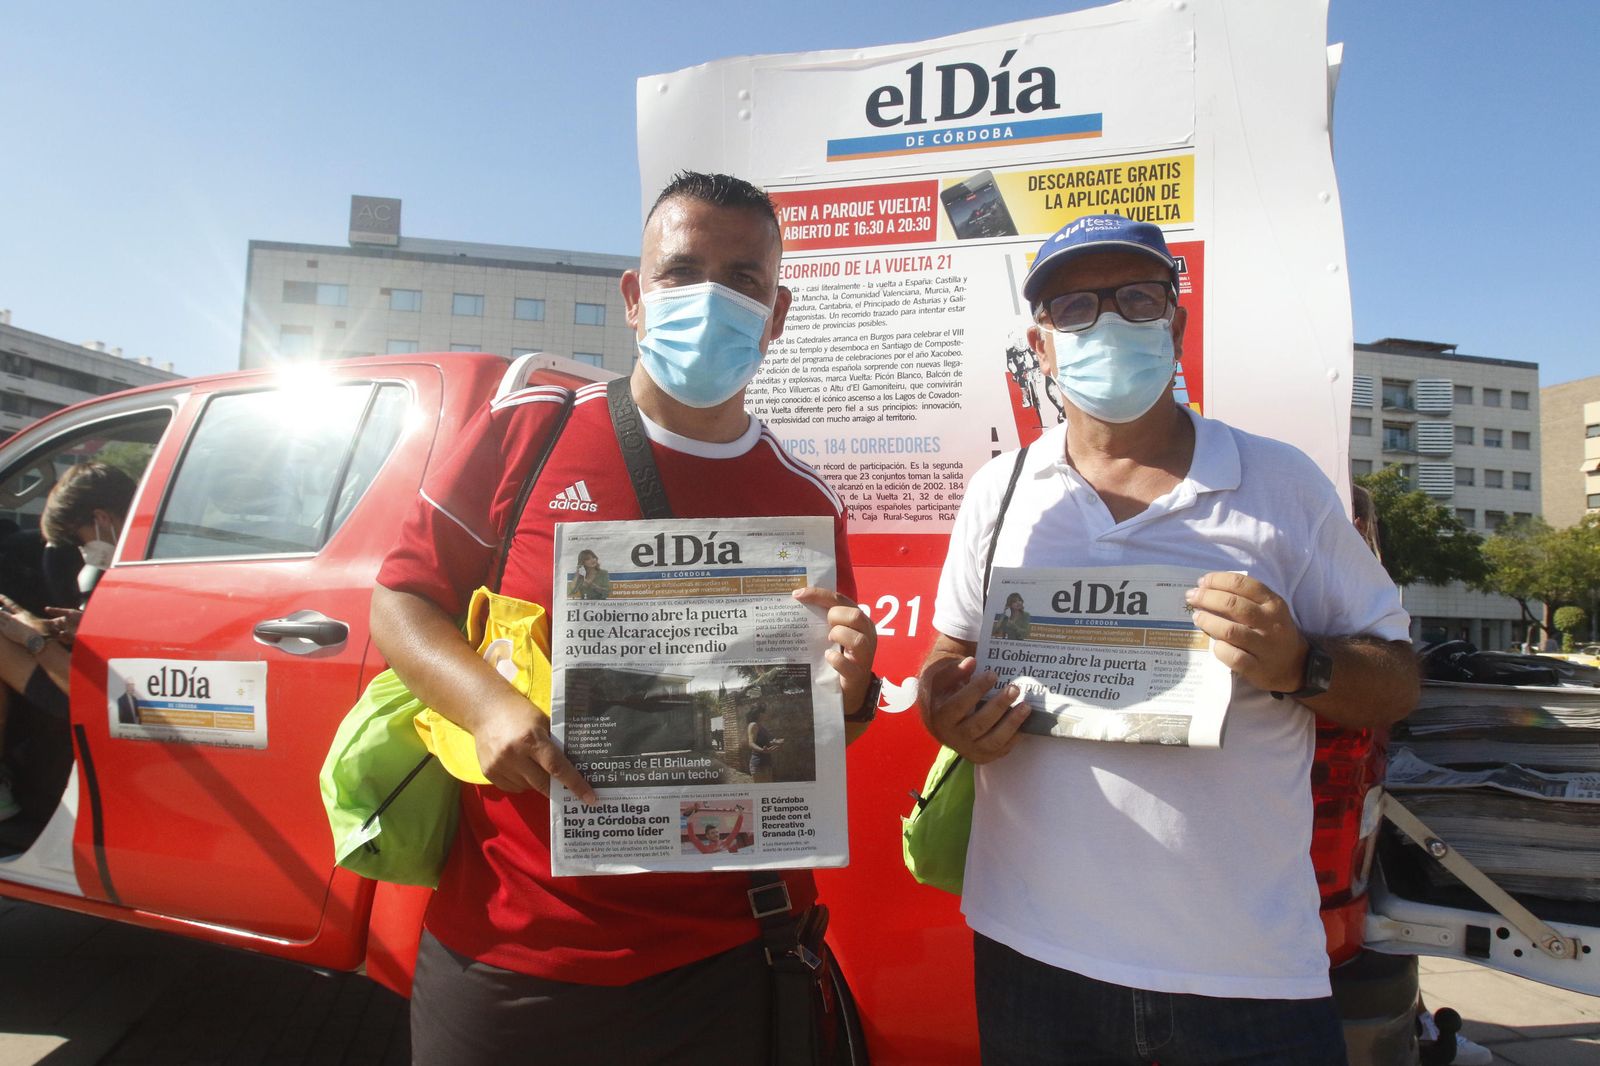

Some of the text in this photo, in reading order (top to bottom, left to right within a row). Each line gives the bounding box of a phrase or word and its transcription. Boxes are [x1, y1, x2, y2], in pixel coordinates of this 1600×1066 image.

[934, 49, 1060, 122] Día
[906, 126, 1013, 147] DE CÓRDOBA
[1028, 162, 1180, 192] DESCARGATE GRATIS
[1046, 182, 1180, 210] LA APLICACIÓN DE
[358, 204, 391, 220] AC
[778, 196, 931, 226] ¡VEN A PARQUE VUELTA!
[1126, 204, 1180, 222] VUELTA
[784, 216, 930, 240] ABIERTO DE 16:30 A 20:30
[780, 254, 952, 280] ECORRIDO DE LA VUELTA 21
[754, 404, 768, 414] Una
[771, 404, 792, 414] Vuelta
[794, 403, 824, 413] diferente
[827, 404, 842, 414] pero
[845, 402, 856, 412] fiel
[882, 400, 918, 412] principios:
[922, 399, 962, 410] innovación,
[782, 436, 940, 456] IPOS, 184 CORREDORES
[824, 460, 845, 470] récord
[848, 460, 857, 470] de
[860, 460, 906, 472] participación.
[910, 460, 920, 469] Es
[922, 460, 930, 469] la
[932, 460, 964, 470] segunda
[844, 472, 858, 482] que
[860, 470, 870, 480] 23
[872, 470, 906, 482] conjuntos
[908, 470, 931, 480] toman
[934, 470, 940, 480] la
[941, 470, 964, 479] salida
[838, 480, 864, 490] alcanzó
[876, 481, 882, 490] la
[884, 480, 910, 490] edición
[912, 481, 922, 490] de
[924, 481, 946, 490] 2002.
[949, 480, 964, 490] 184
[850, 490, 964, 501] de La Vuelta 21, 32 de ellos
[549, 498, 598, 512] adidas
[876, 502, 912, 512] españoles
[860, 511, 956, 522] Caja Rural-Seguros RGA
[672, 531, 743, 566] Día
[1086, 580, 1149, 616] Día
[568, 608, 747, 622] El Gobierno abre la puerta
[566, 622, 738, 641] a que Alcaracejos reciba
[566, 640, 726, 658] ayudas por el incendio
[988, 648, 1000, 660] El
[1002, 650, 1058, 664] Gobierno
[1058, 653, 1088, 666] abre
[1090, 654, 1101, 668] la
[1103, 660, 1146, 671] puerta
[170, 666, 211, 699] Día
[994, 665, 1016, 677] que
[1018, 666, 1091, 683] Alcaracejos
[1093, 670, 1134, 686] reciba
[1050, 684, 1062, 694] el
[1064, 684, 1120, 700] incendio
[590, 761, 632, 772] ocupas
[634, 758, 647, 768] de
[650, 758, 661, 768] El
[664, 757, 712, 768] Brillante
[584, 771, 605, 782] irán
[608, 770, 617, 782] si
[620, 772, 646, 781] "nos
[648, 770, 668, 780] dan
[688, 768, 724, 779] techo"
[564, 803, 650, 815] La Vuelta llega
[762, 814, 786, 822] puede
[788, 812, 802, 820] con
[564, 817, 586, 828] hoy
[597, 815, 646, 826] Córdoba
[648, 816, 670, 824] con
[762, 821, 804, 830] Recreativo
[564, 827, 664, 840] Eiking como líder
[762, 828, 816, 838] Granada (1-0)
